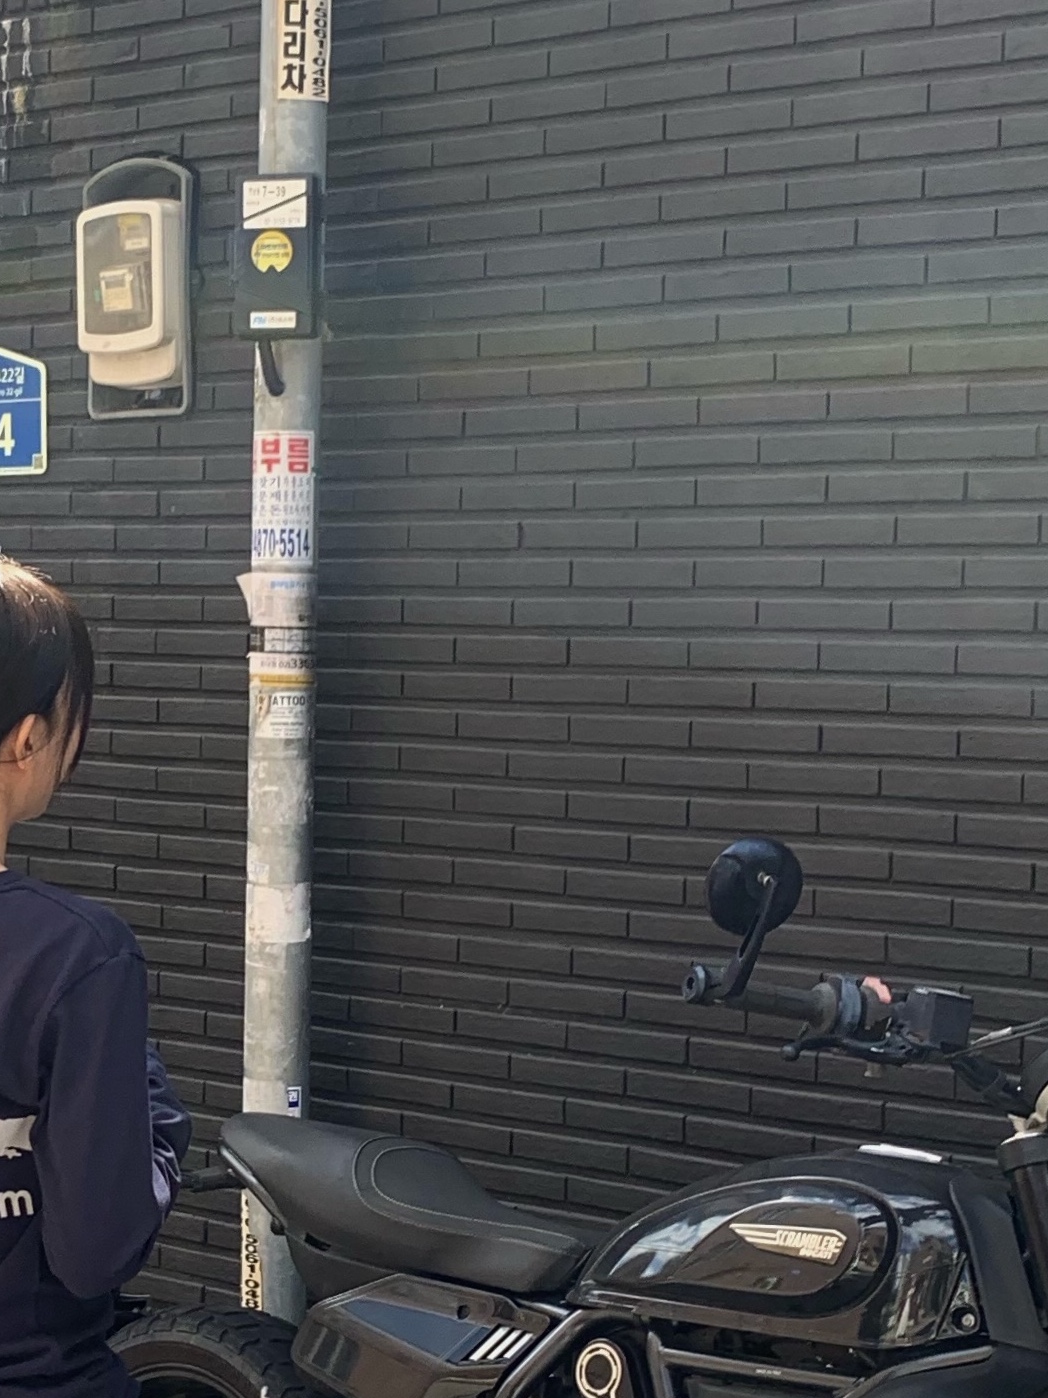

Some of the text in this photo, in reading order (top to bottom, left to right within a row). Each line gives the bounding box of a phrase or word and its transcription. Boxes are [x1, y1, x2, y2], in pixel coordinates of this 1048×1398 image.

[281, 0, 308, 94] 다리차
[253, 437, 310, 473] 부름
[775, 1229, 839, 1252] SCRAMBLER
[799, 1246, 833, 1260] DUCATI
